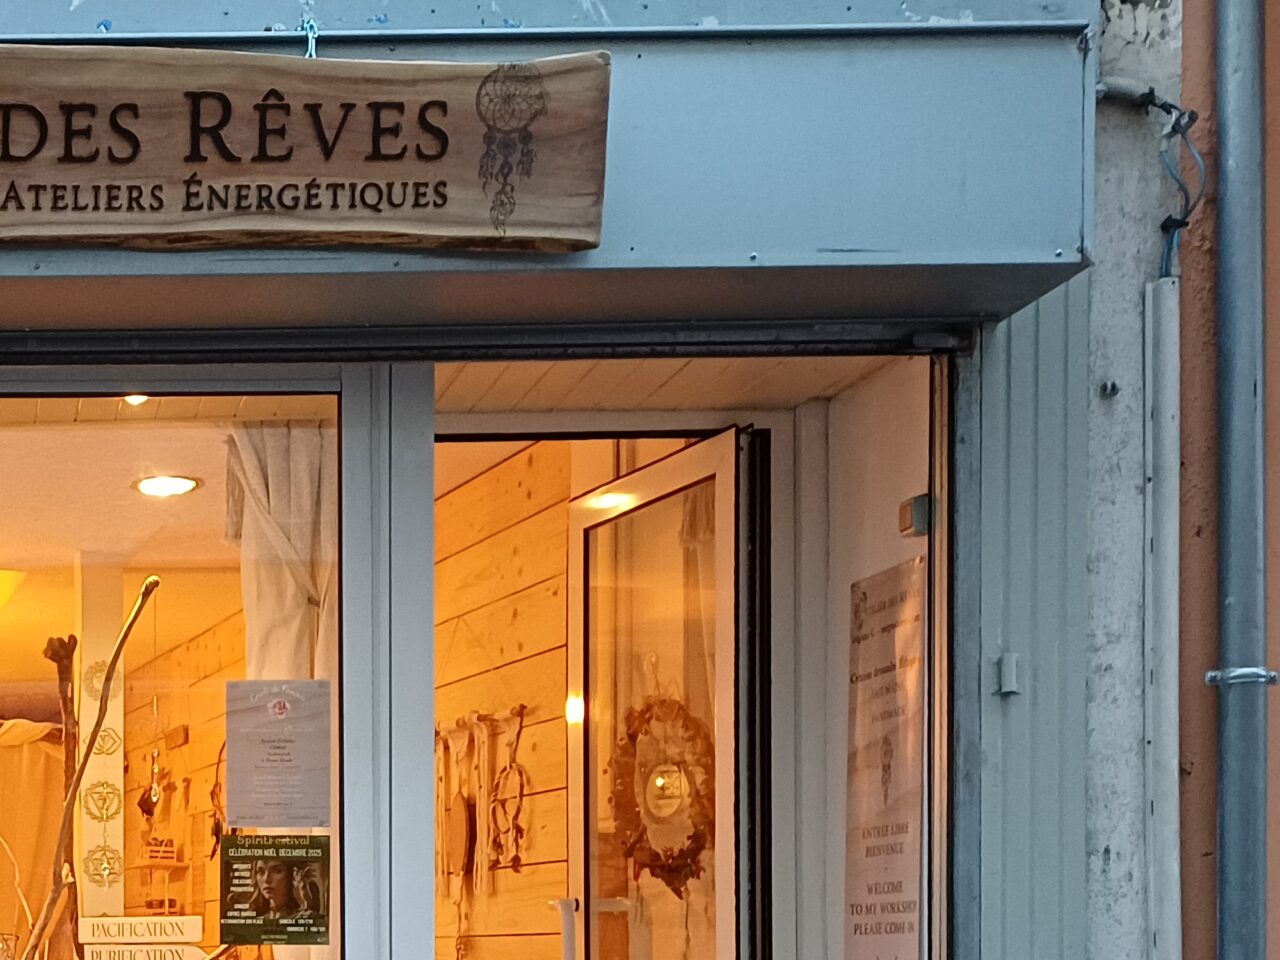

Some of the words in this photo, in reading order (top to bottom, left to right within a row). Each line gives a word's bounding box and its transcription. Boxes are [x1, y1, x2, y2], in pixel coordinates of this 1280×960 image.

[183, 87, 450, 163] RÊVES
[181, 171, 449, 212] ÉNERGÉTIQUES
[849, 903, 863, 916] TO
[865, 903, 877, 915] MY
[91, 921, 184, 938] PACIFICATION
[853, 922, 882, 936] PLEASE
